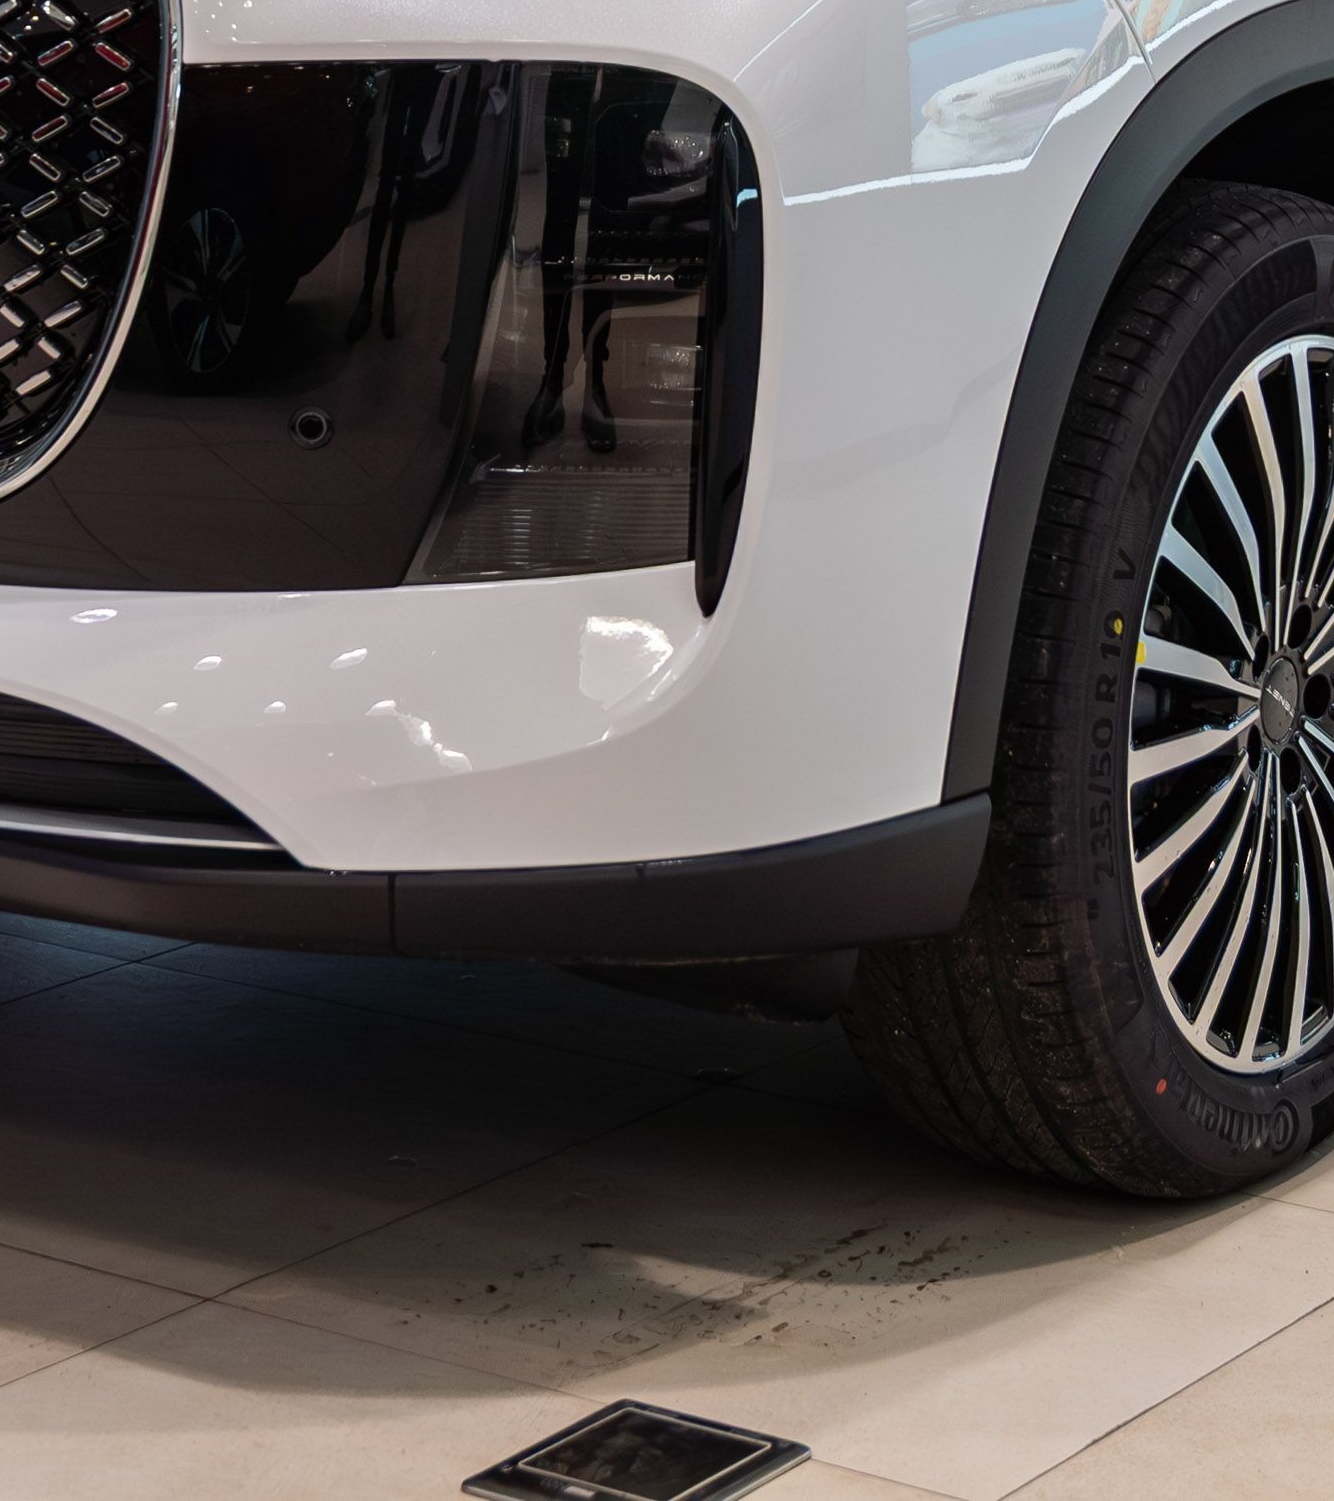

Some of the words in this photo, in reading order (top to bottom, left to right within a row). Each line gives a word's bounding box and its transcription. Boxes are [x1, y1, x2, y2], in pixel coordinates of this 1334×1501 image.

[1112, 545, 1137, 581] V
[1095, 673, 1118, 704] R
[1086, 718, 1115, 887] 235/50
